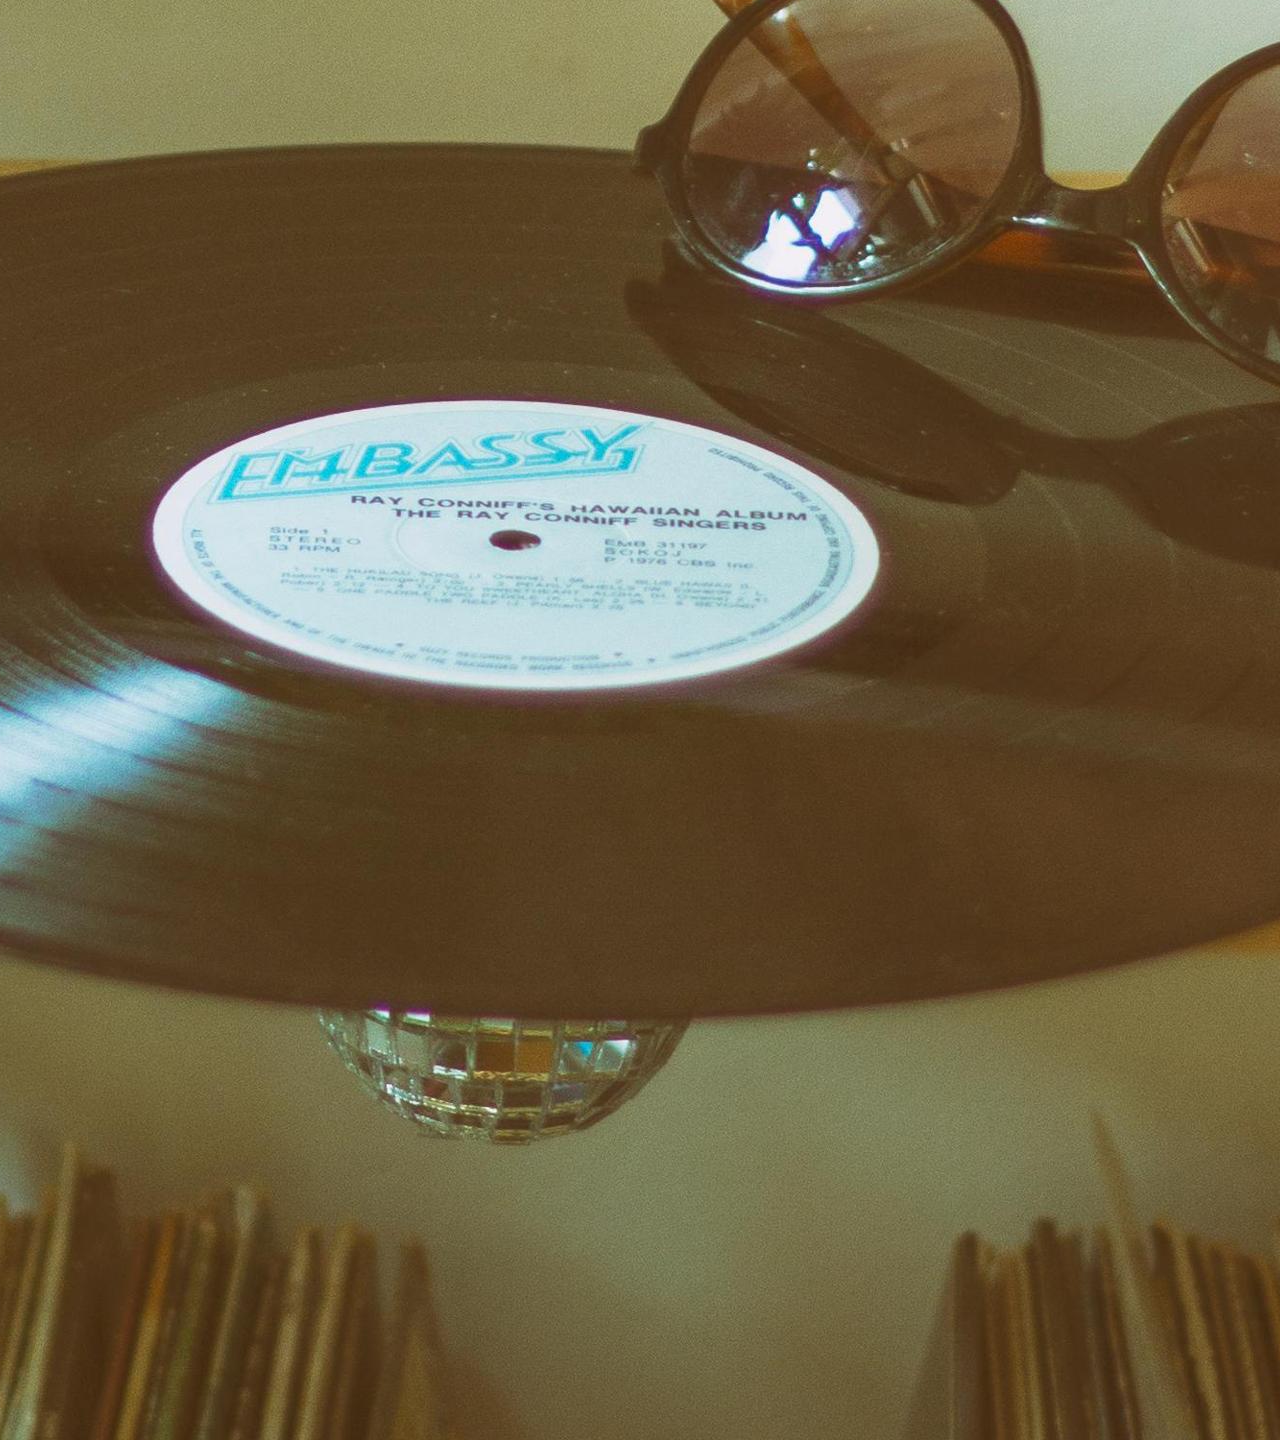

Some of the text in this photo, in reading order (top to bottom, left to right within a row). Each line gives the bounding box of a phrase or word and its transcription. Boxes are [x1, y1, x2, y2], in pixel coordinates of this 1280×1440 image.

[217, 423, 646, 503] EMBASSY
[350, 495, 808, 522] RAY CONNIFF'S HAWAIIAN ALBUM
[392, 508, 767, 531] THE RAY CONNIFF SINGERS
[270, 526, 309, 535] Side
[269, 534, 362, 546] STEREO
[604, 538, 647, 548] EMB
[299, 544, 342, 553] RPM
